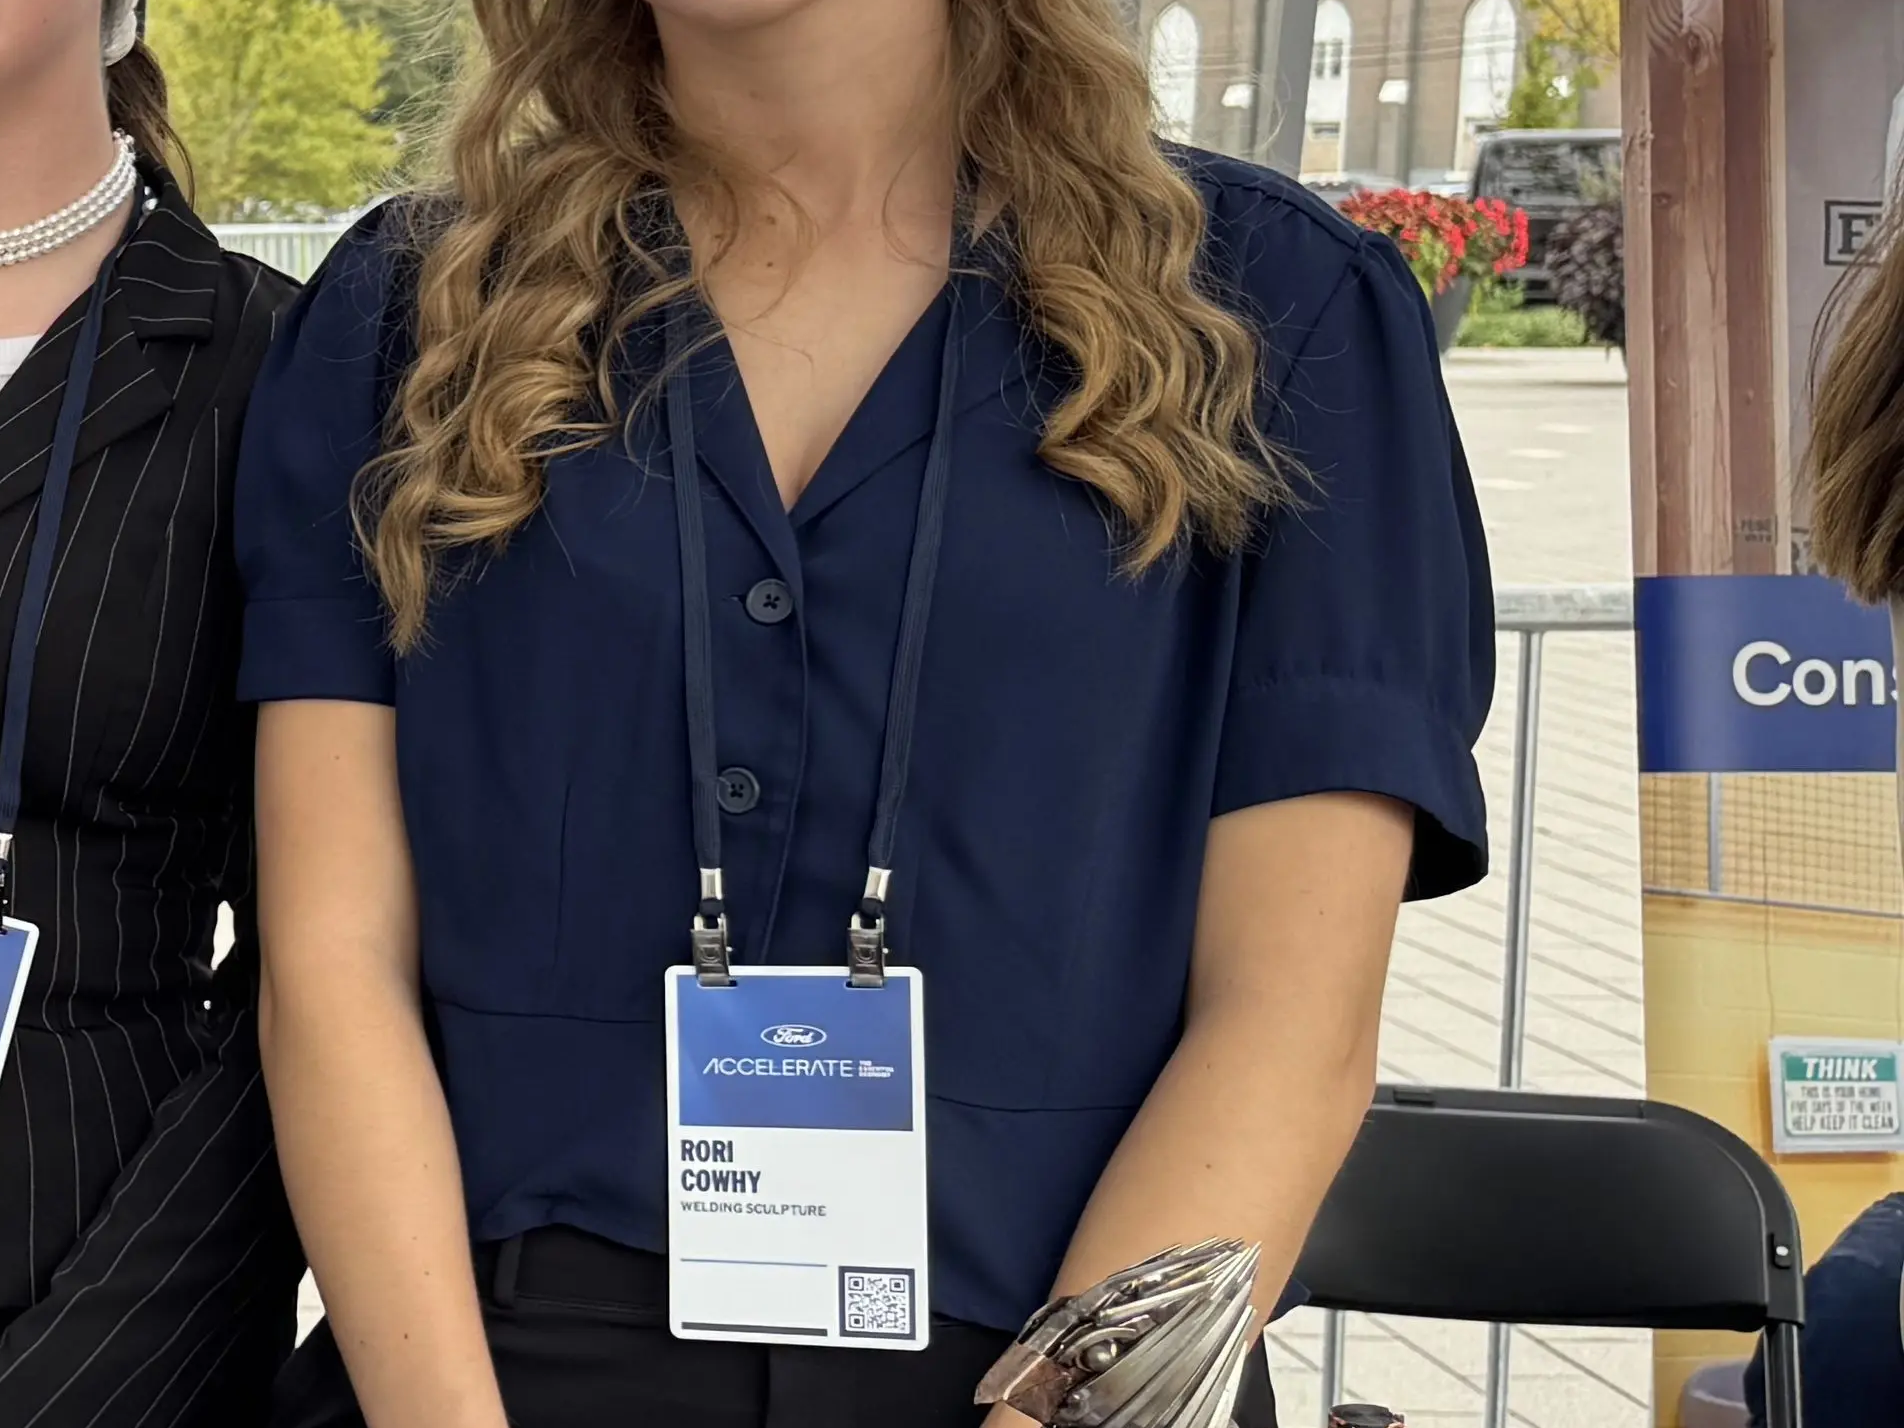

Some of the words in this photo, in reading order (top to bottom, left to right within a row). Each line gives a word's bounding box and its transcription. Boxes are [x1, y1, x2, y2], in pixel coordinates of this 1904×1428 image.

[1732, 640, 1898, 707] Con
[703, 1058, 853, 1077] ACCELERATE
[1803, 1058, 1878, 1079] THINK
[681, 1139, 733, 1163] RORI
[681, 1170, 762, 1194] COWHY
[681, 1201, 743, 1215] WELDING
[746, 1203, 827, 1217] SCULPTURE
